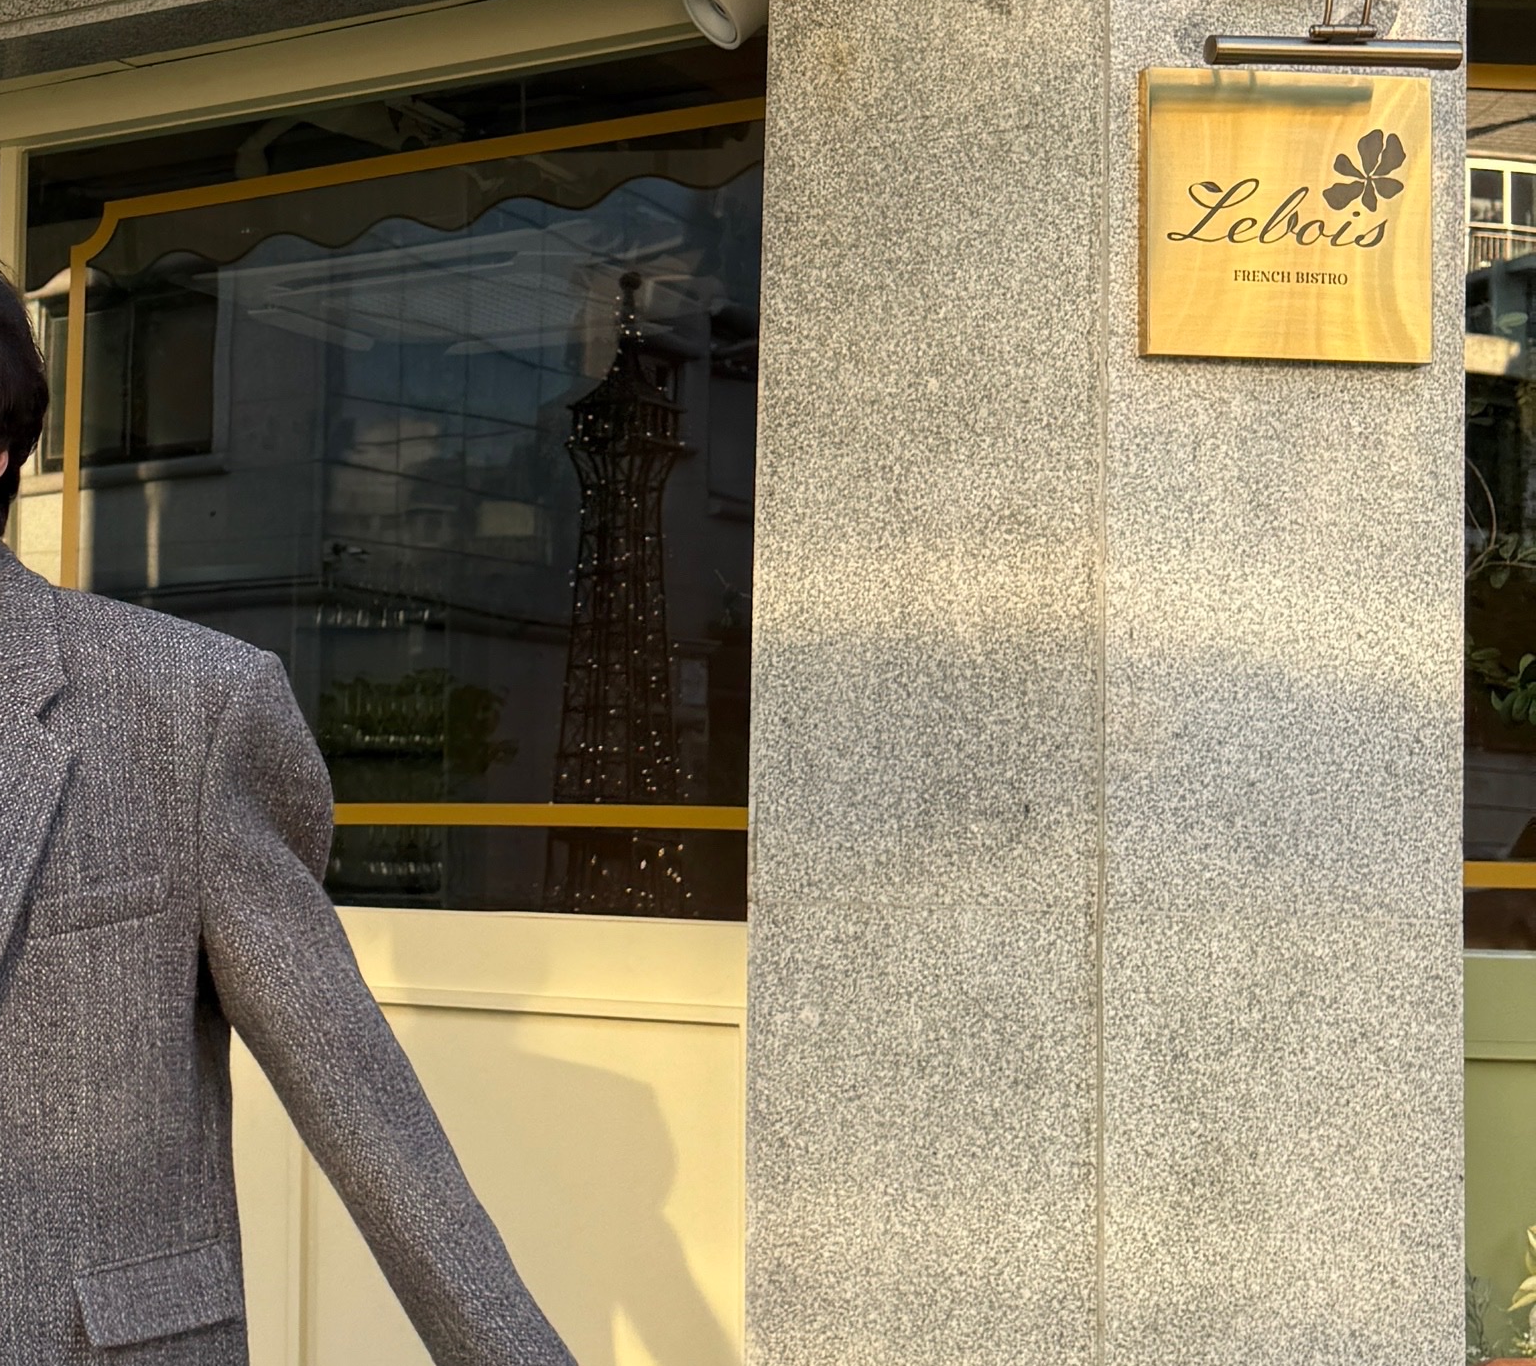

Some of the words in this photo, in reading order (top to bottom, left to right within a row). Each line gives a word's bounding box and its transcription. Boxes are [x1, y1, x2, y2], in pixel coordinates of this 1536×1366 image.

[1166, 177, 1389, 249] Lebois
[1233, 269, 1292, 284] FRENCH
[1295, 271, 1349, 286] BISTRO
